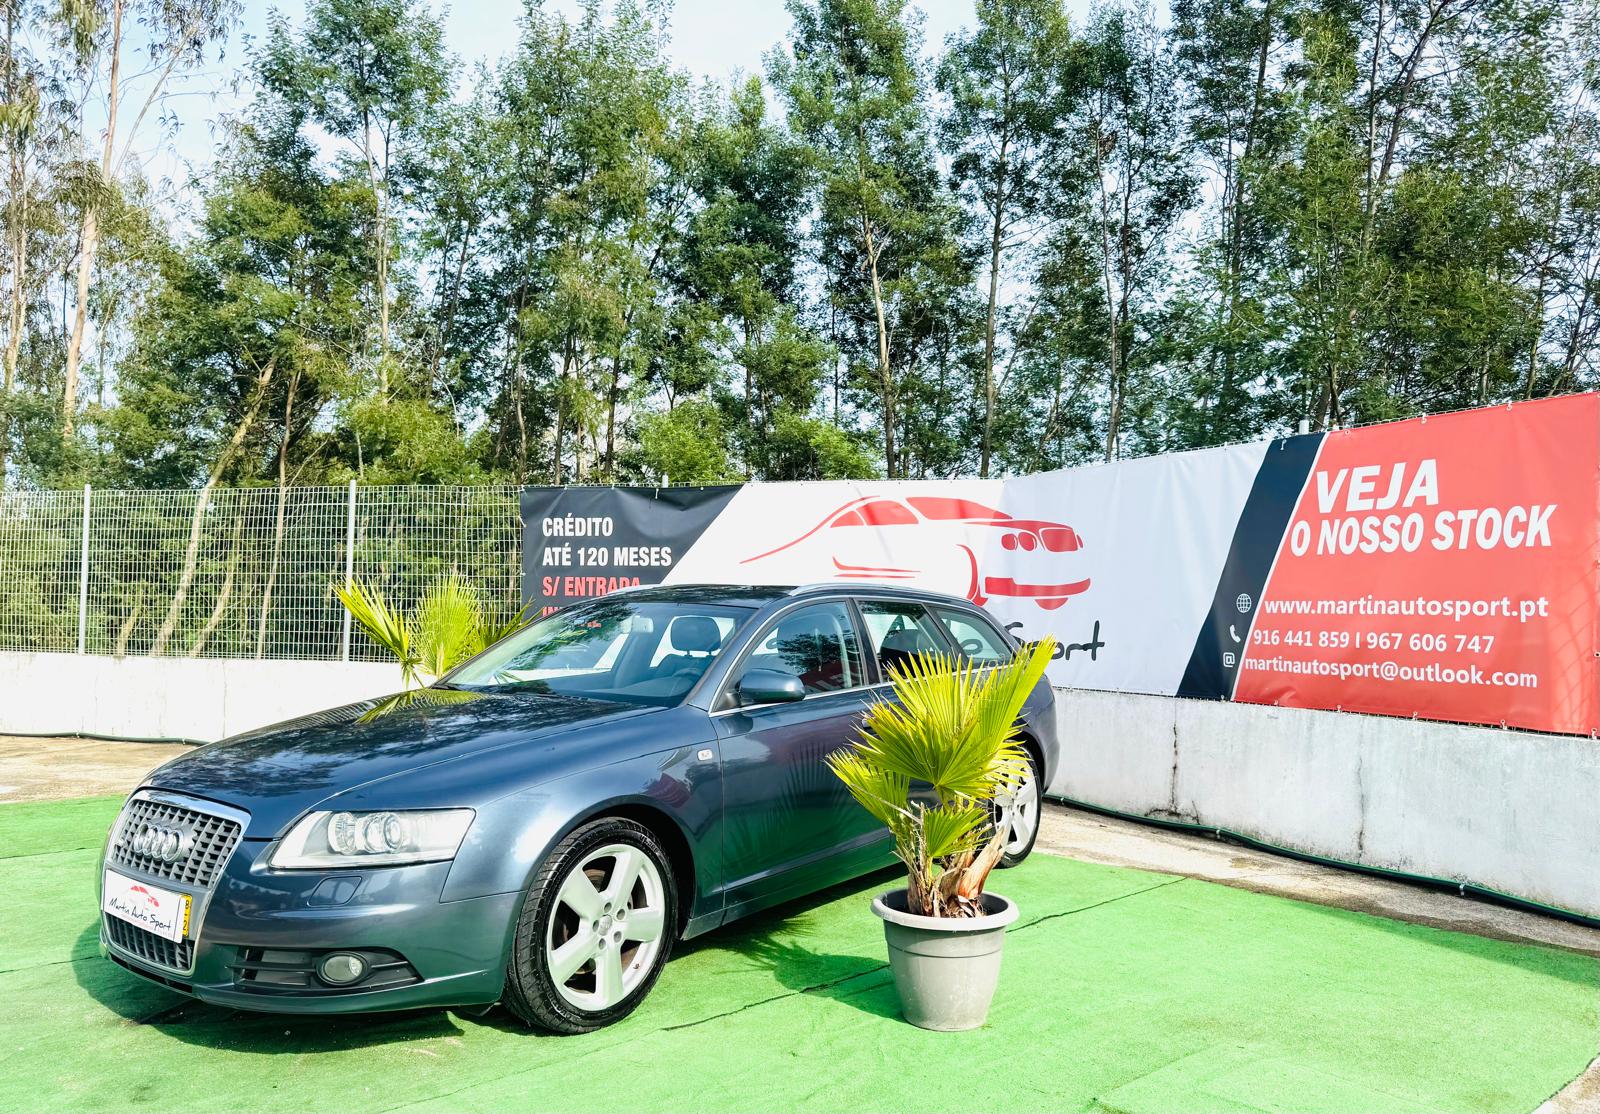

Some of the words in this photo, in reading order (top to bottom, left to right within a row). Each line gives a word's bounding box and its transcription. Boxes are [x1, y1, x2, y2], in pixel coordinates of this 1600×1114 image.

[1316, 459, 1439, 513] VEJA
[542, 512, 613, 537] CRÉDITO
[1291, 520, 1311, 557] O
[1317, 512, 1424, 555] NOSSO
[1431, 504, 1557, 550] STOCK
[542, 542, 572, 566] ATÉ
[578, 547, 609, 566] 120
[614, 547, 672, 567] MESES
[543, 576, 560, 597] S/
[1264, 594, 1549, 623] www.martinautosport.pt
[1254, 630, 1280, 645] 916
[1284, 630, 1313, 646] 441
[1318, 631, 1349, 648] 859
[1366, 632, 1402, 650] 967
[1409, 633, 1447, 652] 606
[1454, 634, 1494, 653] 747
[1245, 656, 1537, 688] martinautosport@outlook.com
[109, 897, 130, 913] Martin
[131, 905, 148, 921] Auto
[150, 914, 171, 931] Sport
